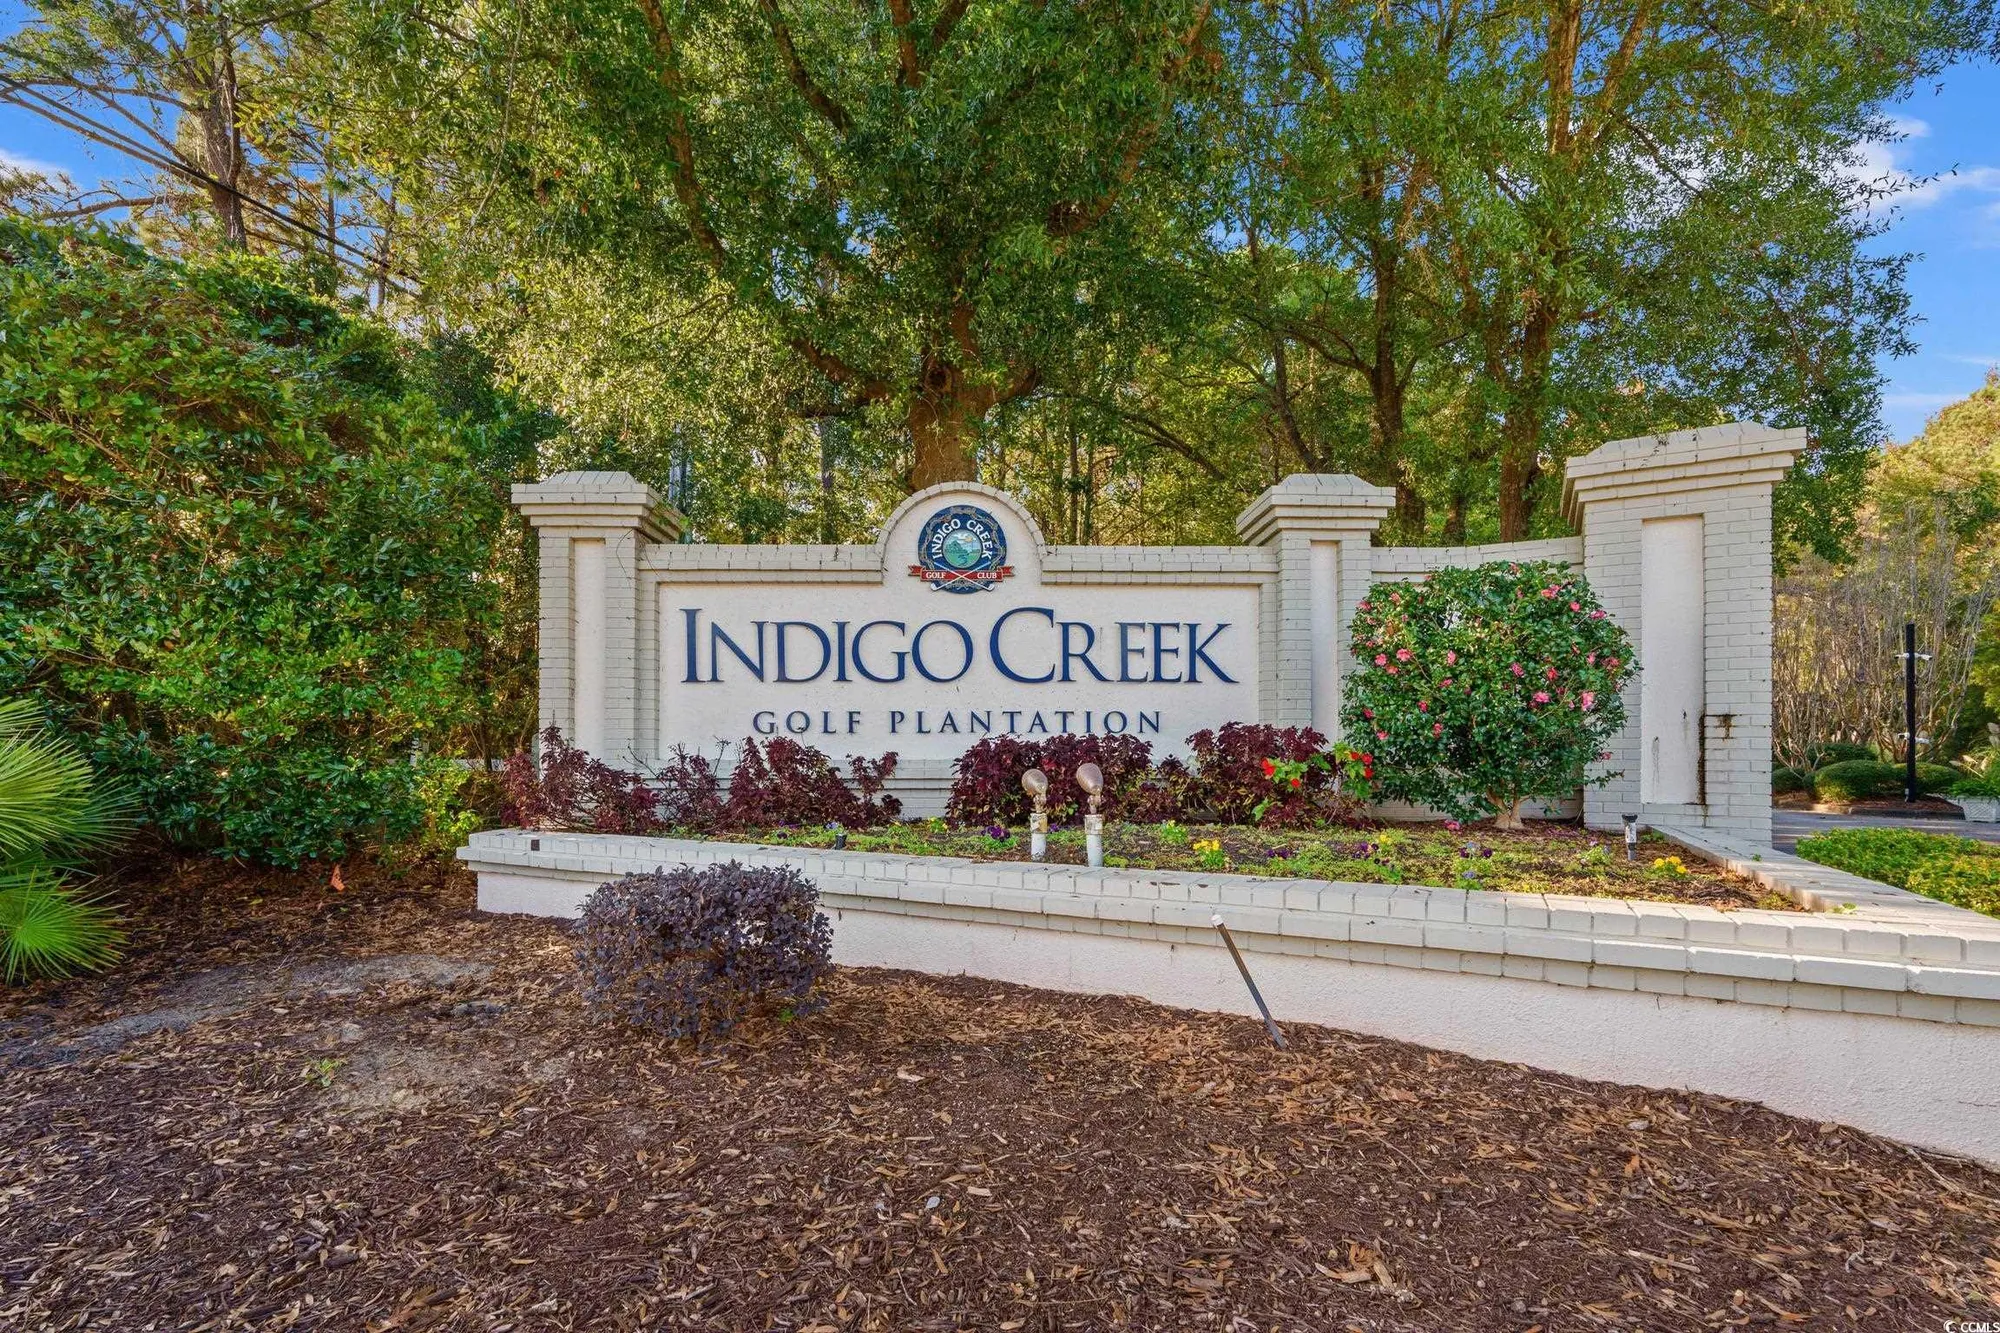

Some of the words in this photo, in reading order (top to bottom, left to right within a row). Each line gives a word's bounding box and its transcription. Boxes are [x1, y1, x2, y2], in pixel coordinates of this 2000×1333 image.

[932, 518, 961, 560] INDIGO
[966, 519, 994, 560] CREEK
[925, 571, 947, 579] GOLF
[977, 571, 997, 579] CLUB
[679, 608, 974, 684] INDIGO
[989, 606, 1239, 684] CREEK
[752, 710, 861, 734] GOLF
[889, 710, 1161, 734] PLANTATION
